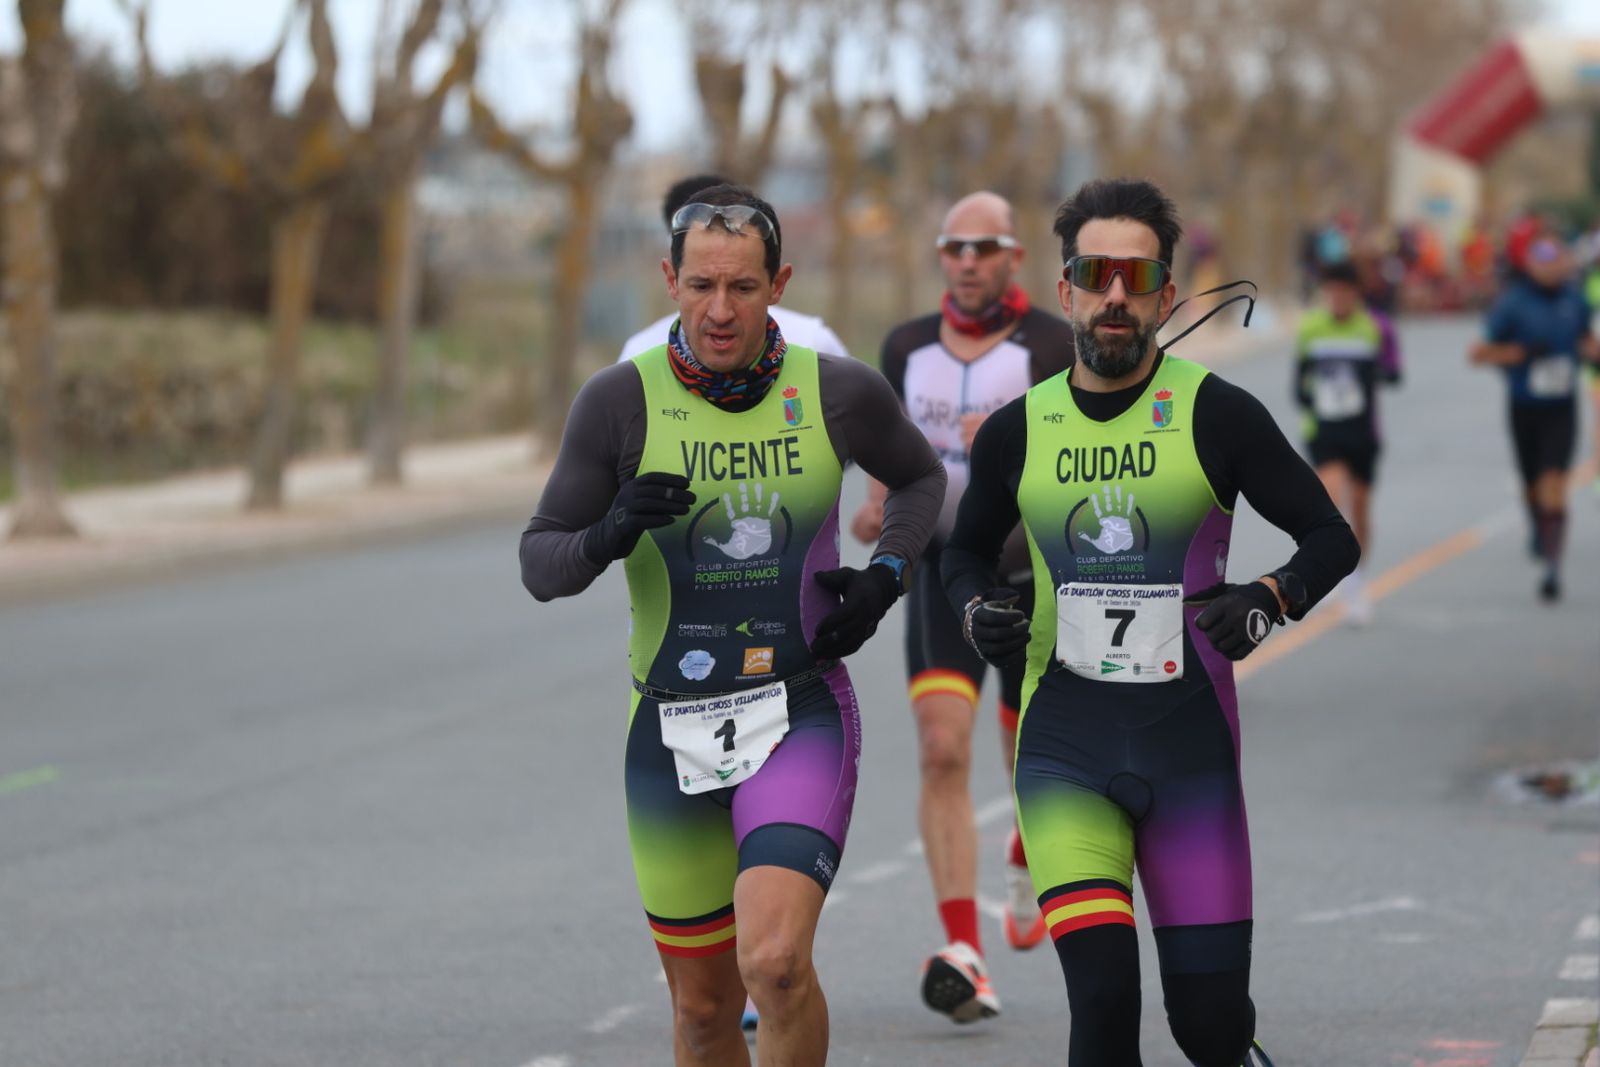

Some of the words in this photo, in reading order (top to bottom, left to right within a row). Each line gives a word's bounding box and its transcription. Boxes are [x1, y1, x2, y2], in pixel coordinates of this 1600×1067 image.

[681, 436, 803, 482] VICENTE
[1056, 441, 1156, 484] CIUDAD
[695, 563, 722, 571] CLUB
[725, 558, 779, 570] DEPORTIVO
[1076, 556, 1097, 564] CLUB
[1099, 555, 1144, 563] DEPORTIVO
[695, 570, 742, 583] ROBERTO
[745, 566, 779, 580] RAMOS
[1077, 564, 1114, 574] ROBERTO
[1116, 563, 1145, 573] RAMOS
[694, 579, 778, 591] FISIOTERAPIA
[1060, 587, 1069, 596] VI
[1071, 586, 1104, 597] DUATLÓN
[1106, 588, 1131, 598] CROSS
[1133, 588, 1180, 599] VILLAMAYOR
[1105, 608, 1136, 647] 7
[663, 708, 673, 717] VI
[675, 702, 706, 716] DUATLÓN
[707, 699, 732, 711] CROSS
[734, 687, 782, 706] VILLAMAYOR
[714, 718, 736, 752] 1
[720, 757, 735, 766] NIKO
